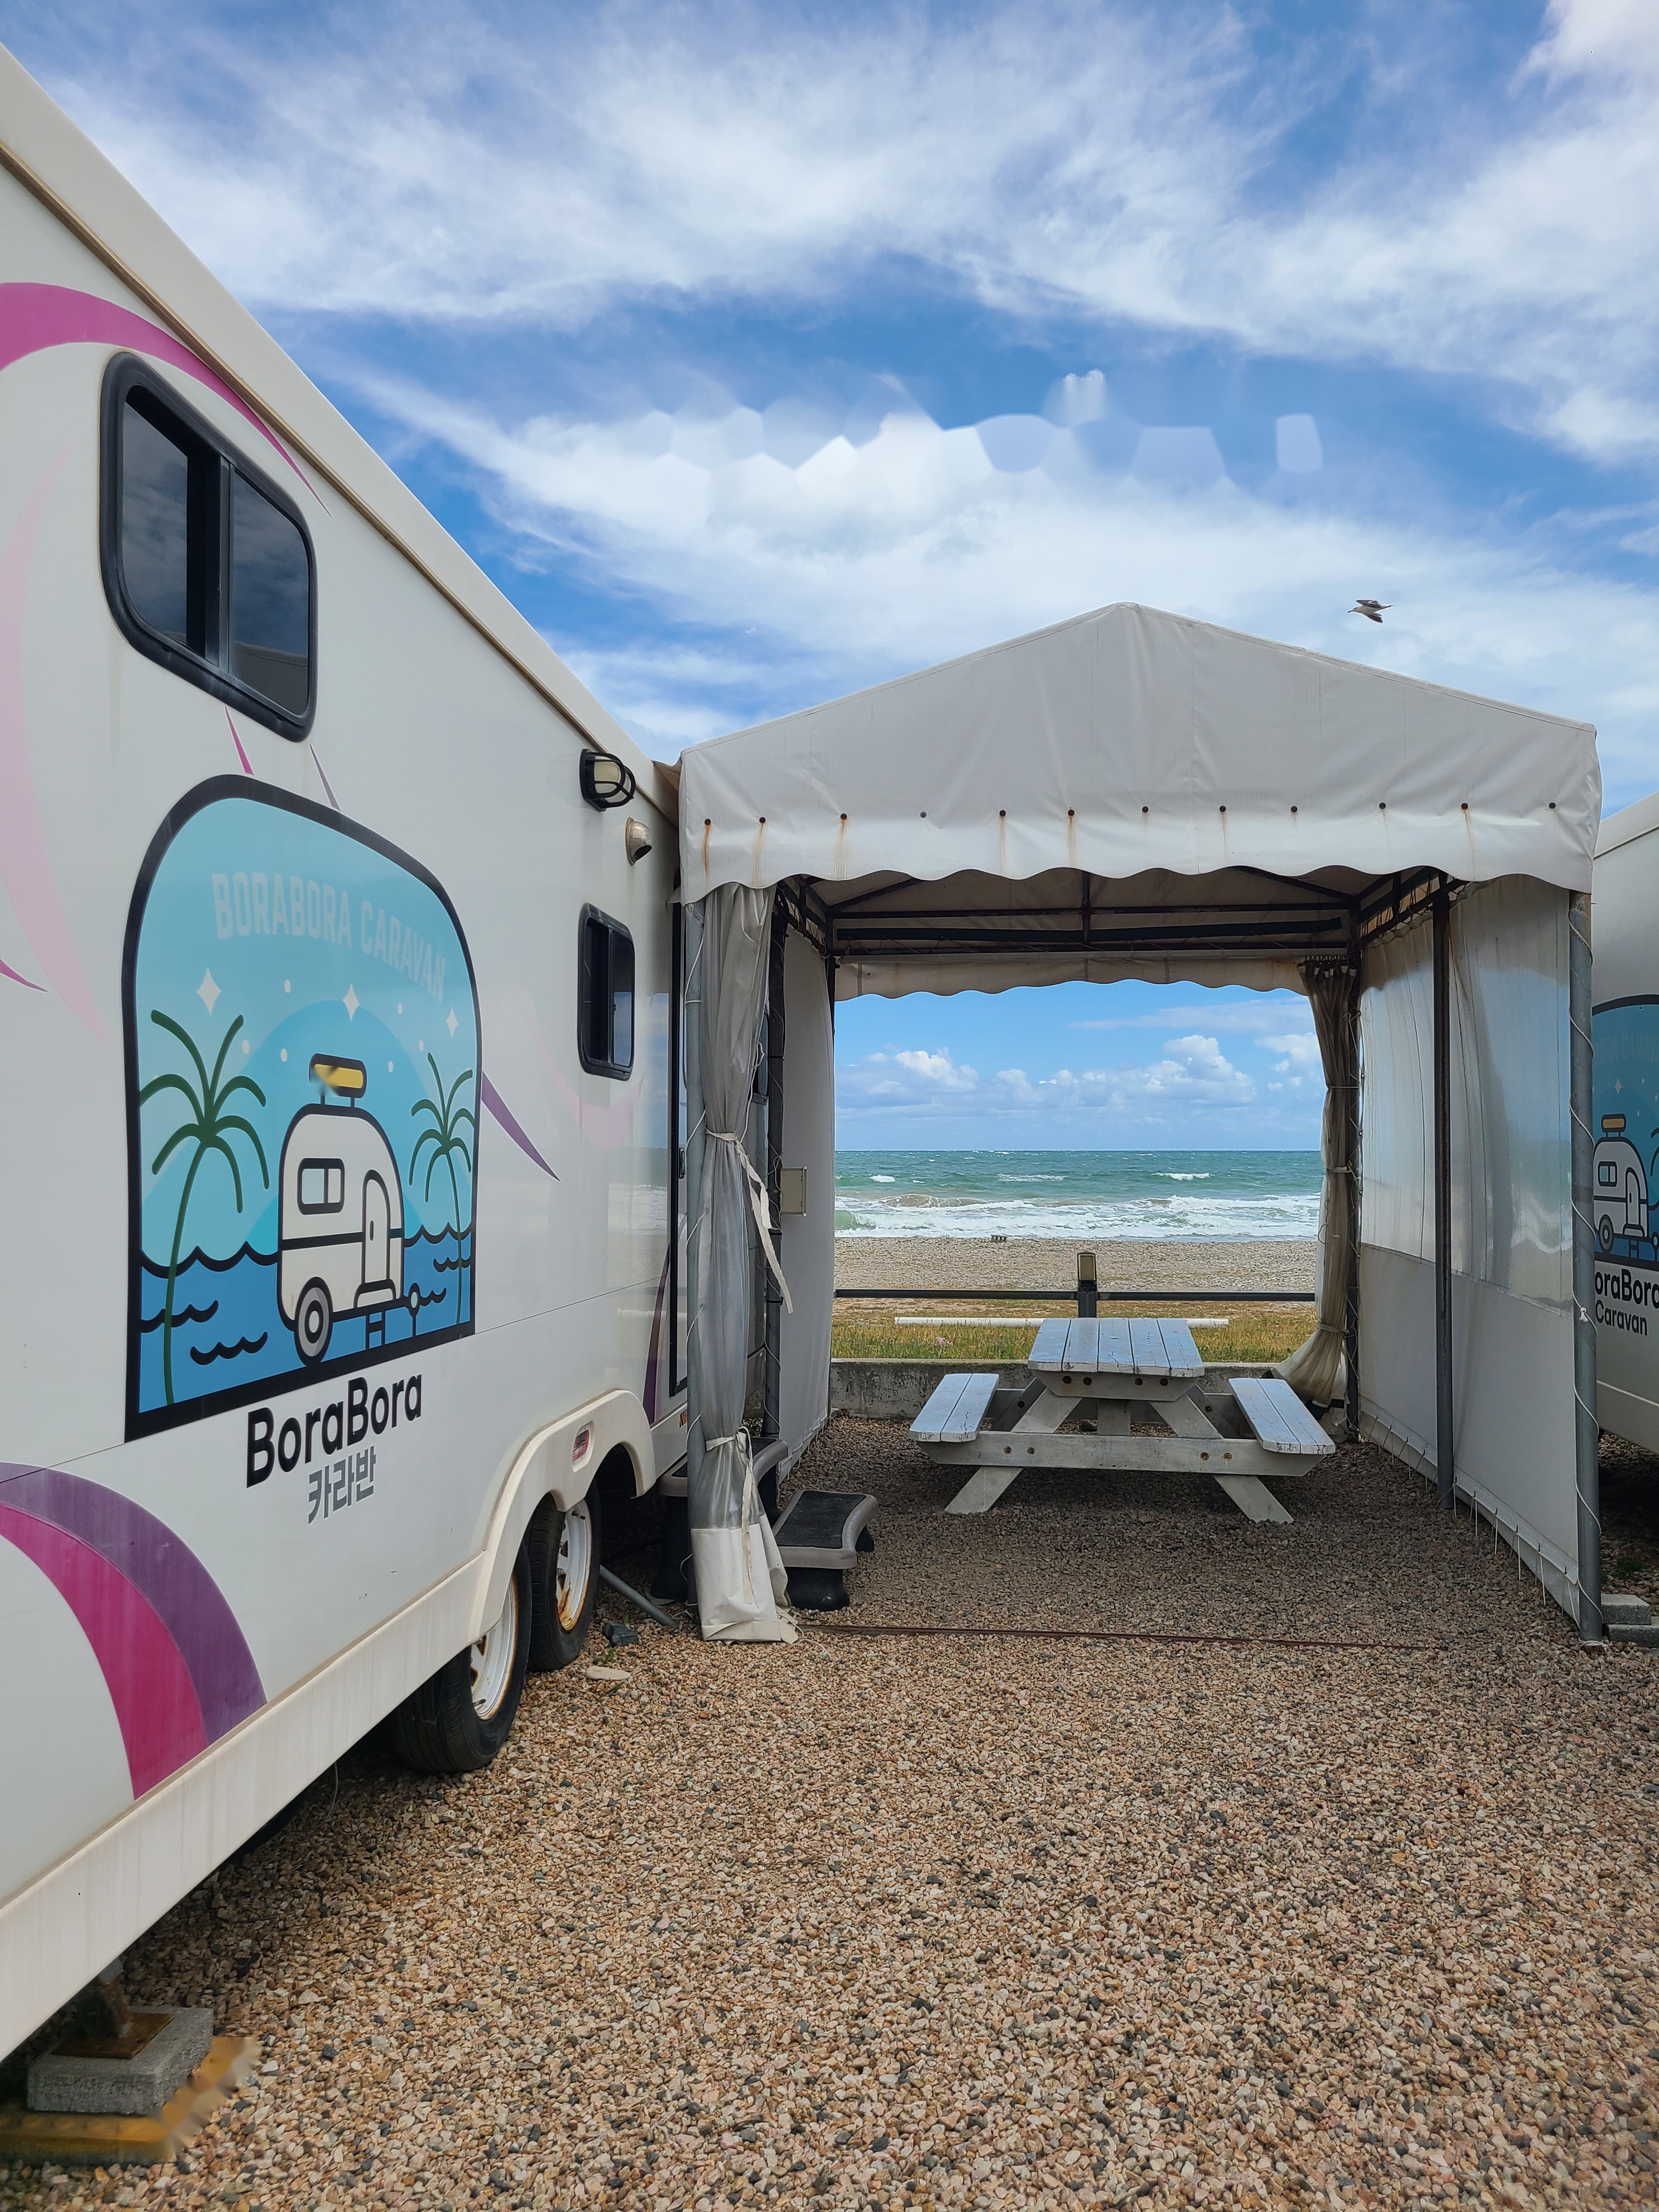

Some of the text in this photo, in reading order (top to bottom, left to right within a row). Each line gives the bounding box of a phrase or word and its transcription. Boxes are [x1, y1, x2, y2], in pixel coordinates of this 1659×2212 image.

[212, 872, 446, 1003] BORABORA CARAVAN
[1595, 1268, 1659, 1309] oraBora
[1595, 1299, 1647, 1335] Caravan
[246, 1374, 422, 1488] BoraBora
[308, 1446, 376, 1525] 카라반
